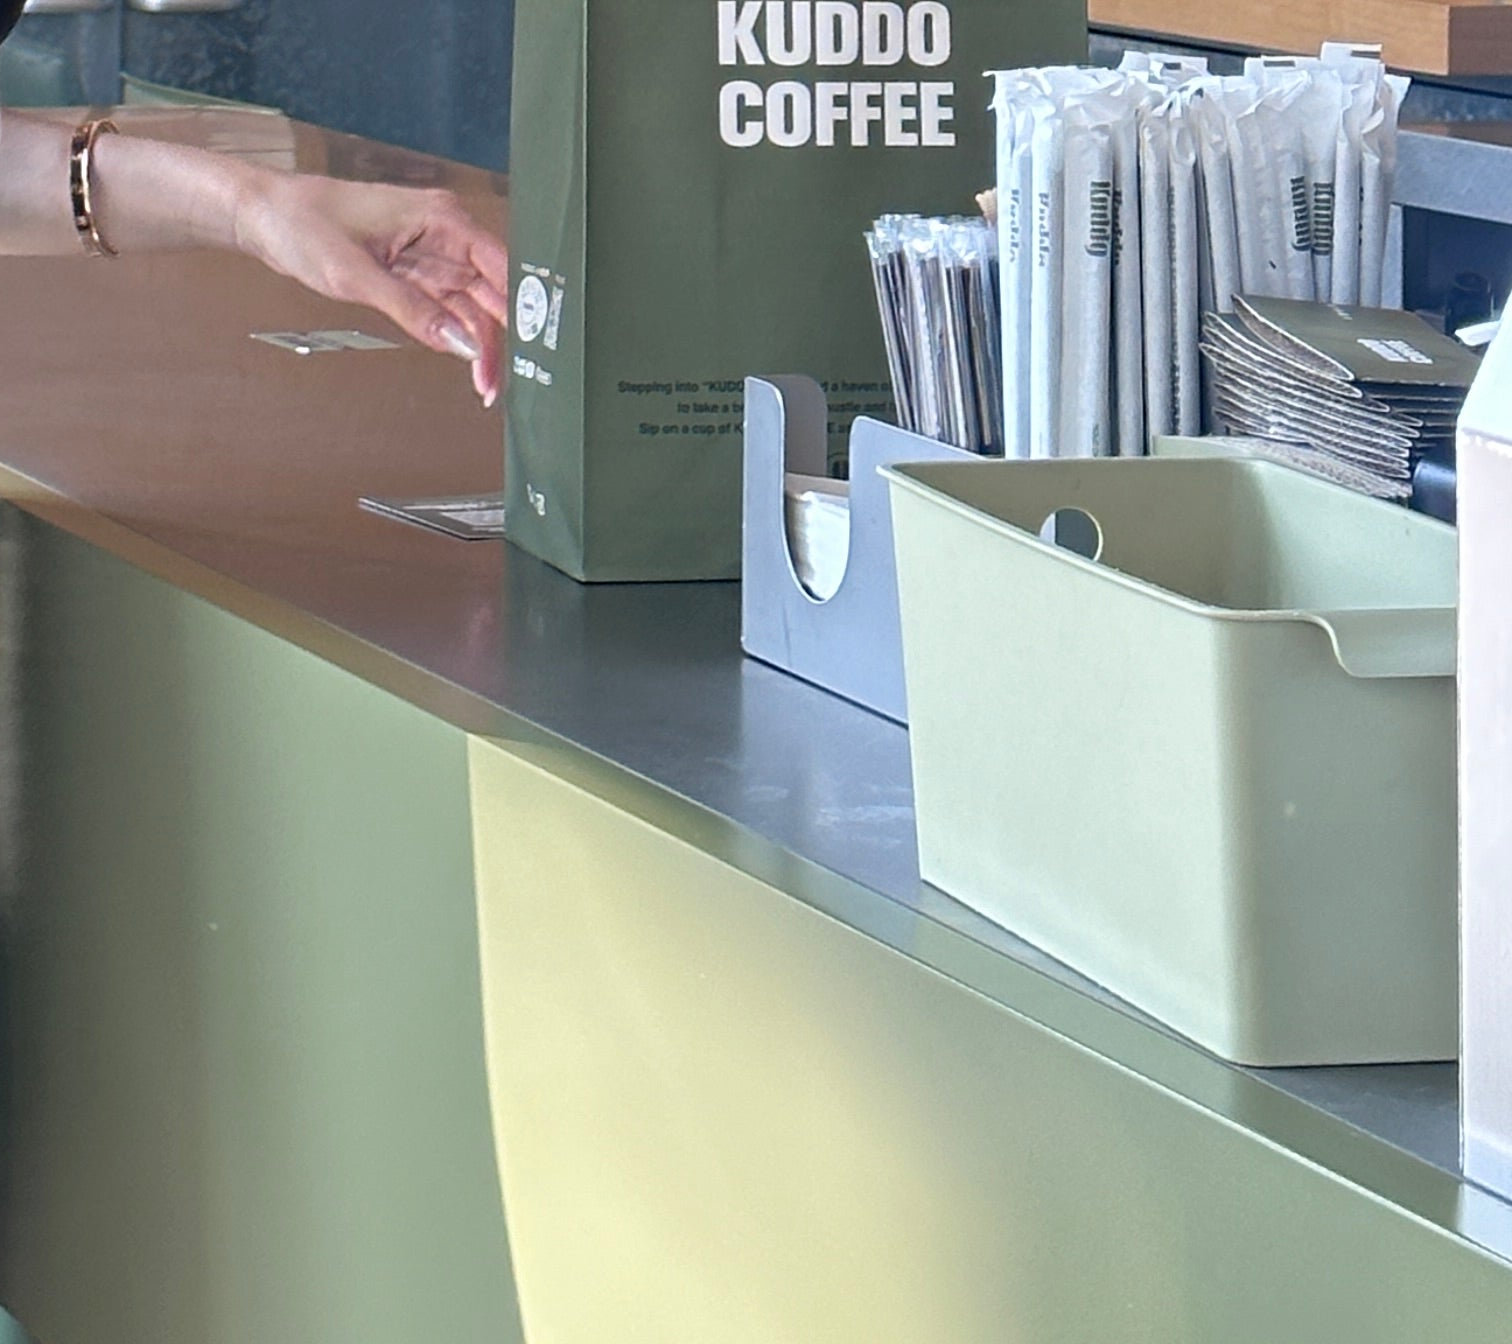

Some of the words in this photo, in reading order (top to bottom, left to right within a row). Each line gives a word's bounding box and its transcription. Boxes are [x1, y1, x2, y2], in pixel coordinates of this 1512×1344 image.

[717, 0, 951, 66] KUDDO
[719, 80, 956, 147] COFFEE
[617, 380, 673, 395] Stepping
[675, 380, 700, 393] into
[692, 402, 720, 414] take
[639, 422, 660, 436] Sip
[662, 424, 679, 434] on
[691, 424, 716, 437] cup
[718, 422, 732, 434] of
